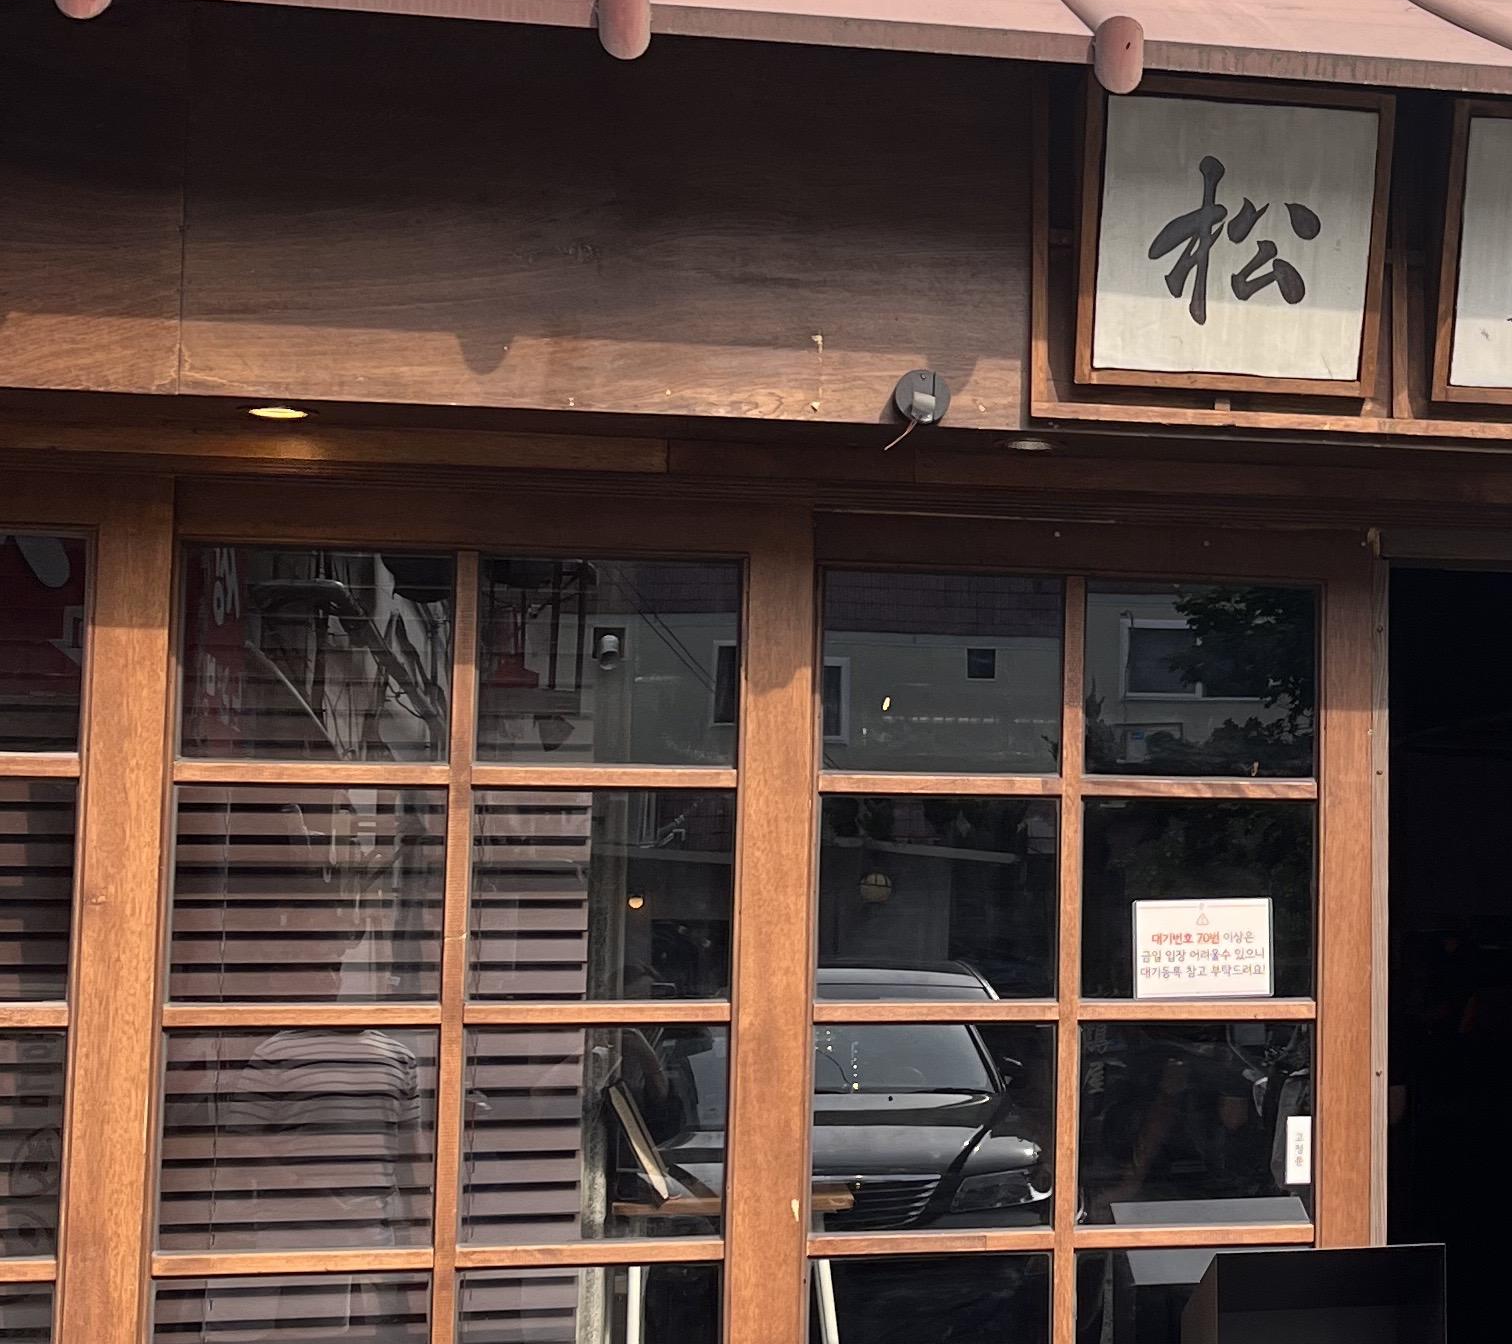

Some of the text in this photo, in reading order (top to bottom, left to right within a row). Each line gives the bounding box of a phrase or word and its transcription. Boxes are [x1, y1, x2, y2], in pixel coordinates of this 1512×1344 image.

[1151, 930, 1255, 945] 대기번호 70번 이상은
[1141, 949, 1162, 963] 금일
[1165, 949, 1187, 962] 입장
[1234, 947, 1265, 960] 있으니
[1186, 965, 1208, 978] 참고
